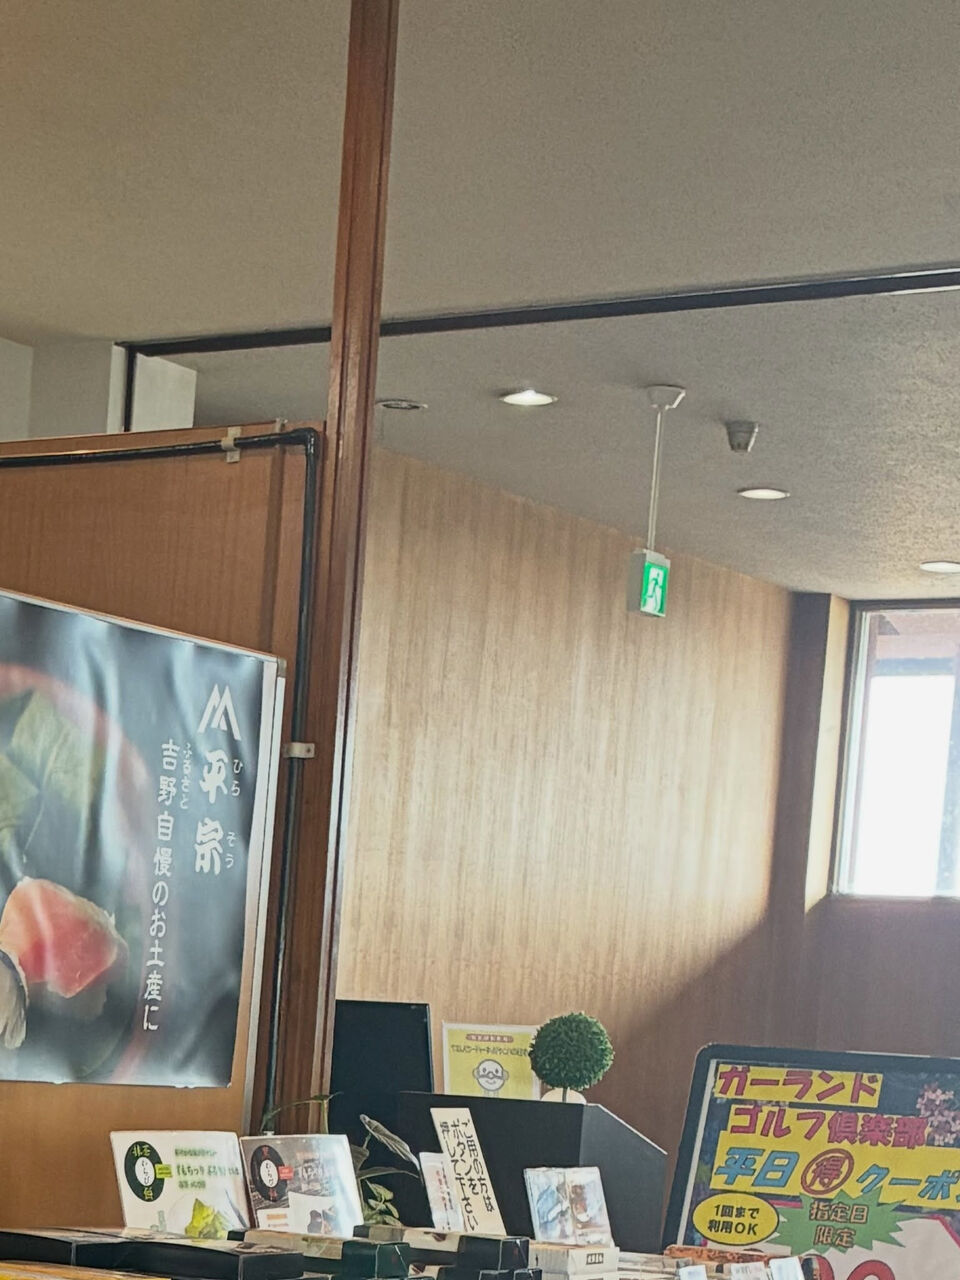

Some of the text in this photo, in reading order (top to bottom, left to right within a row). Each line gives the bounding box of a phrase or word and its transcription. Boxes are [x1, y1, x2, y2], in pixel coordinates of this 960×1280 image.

[142, 738, 181, 1032] 吉野自慢のお土産に
[718, 1065, 879, 1104] ガーランド
[730, 1104, 929, 1150] ゴルフ倶楽部
[713, 1203, 760, 1220] 1回まで
[809, 1200, 870, 1224] 指定日
[707, 1219, 759, 1237] 利用OK
[813, 1225, 857, 1248] 限定
